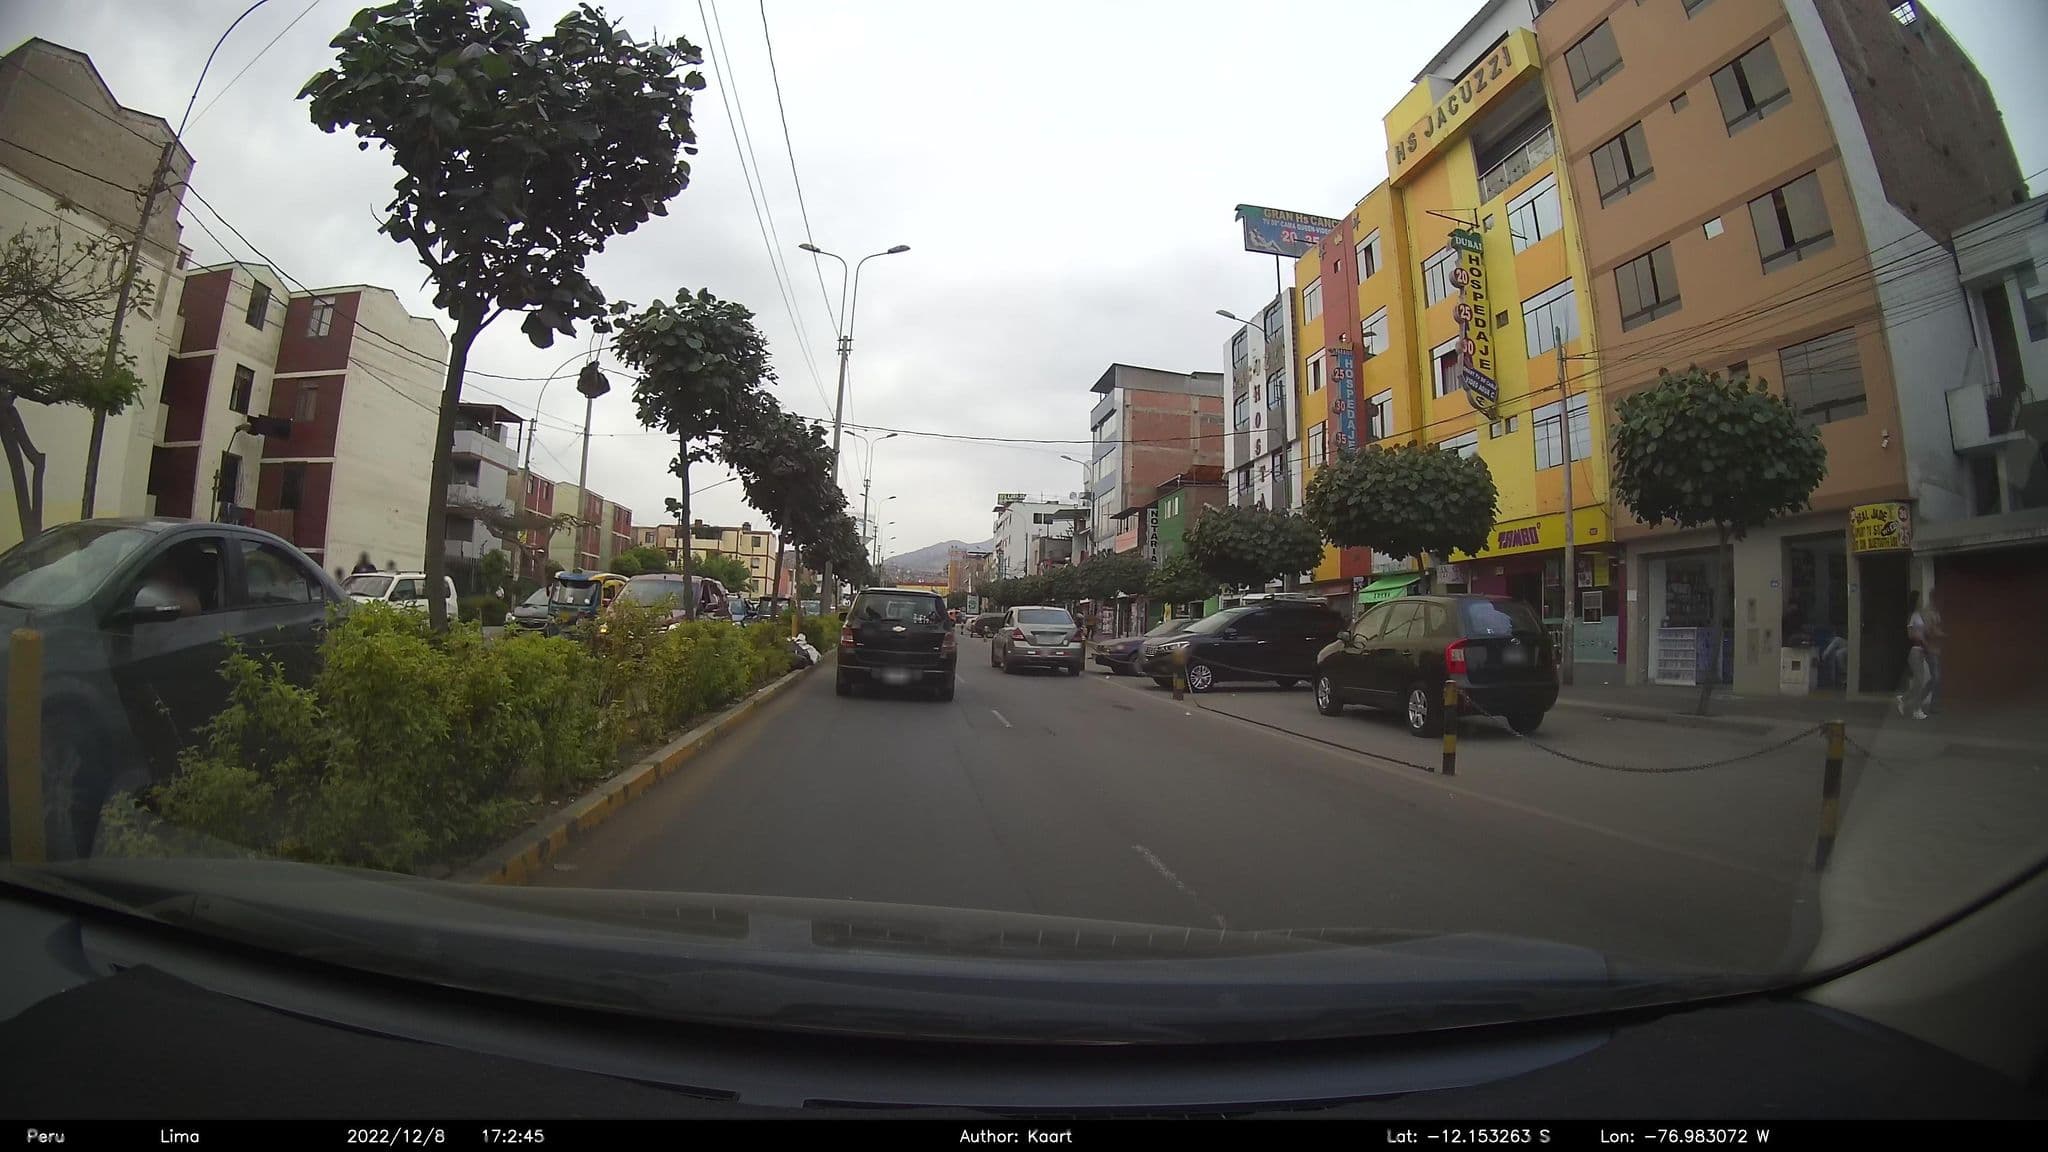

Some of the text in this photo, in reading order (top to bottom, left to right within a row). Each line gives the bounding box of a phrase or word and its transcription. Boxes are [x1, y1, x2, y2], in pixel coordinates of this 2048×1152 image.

[1395, 46, 1512, 165] HS JACUZZI
[1263, 208, 1294, 221] GRAN
[1310, 216, 1338, 229] CANC
[1282, 230, 1298, 243] 20
[1455, 236, 1482, 250] DUBAI
[1456, 270, 1469, 284] 20
[1459, 306, 1472, 321] 25
[1468, 254, 1491, 370] HOSPEDAJE
[1334, 367, 1345, 380] 25
[1344, 359, 1356, 451] HOSPEDAJE
[1150, 510, 1159, 562] NOTARIA
